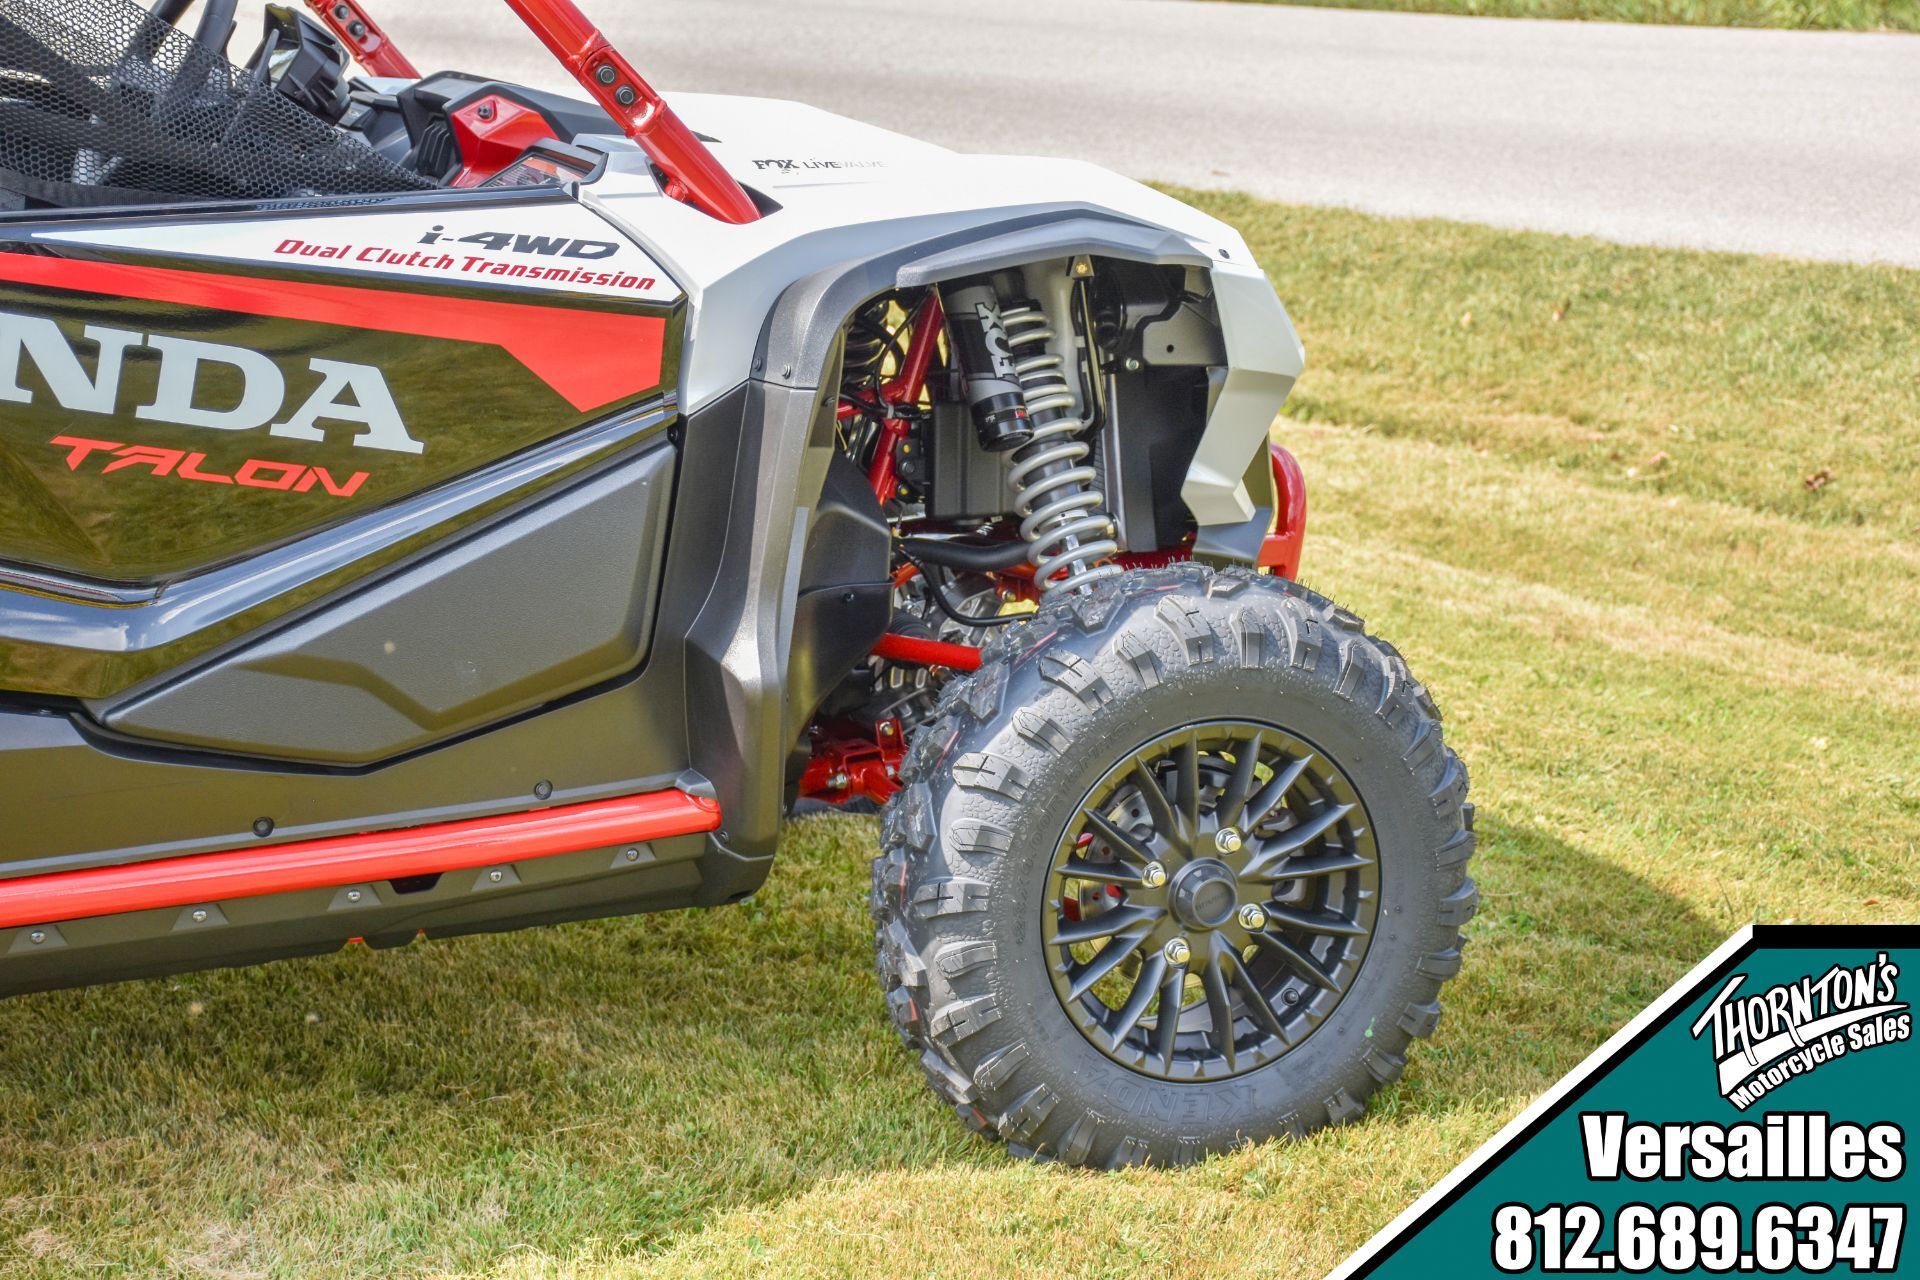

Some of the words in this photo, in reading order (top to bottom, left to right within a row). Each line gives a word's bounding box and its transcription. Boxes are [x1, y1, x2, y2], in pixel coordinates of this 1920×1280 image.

[751, 158, 800, 170] FOX
[273, 239, 353, 260] Dual
[355, 247, 455, 270] Clutch
[460, 256, 656, 290] Transmission
[417, 225, 620, 260] i-4WD
[974, 301, 1022, 379] FOX
[0, 311, 424, 455] NDA
[50, 435, 371, 498] TALON
[1072, 1053, 1257, 1126] KENDA
